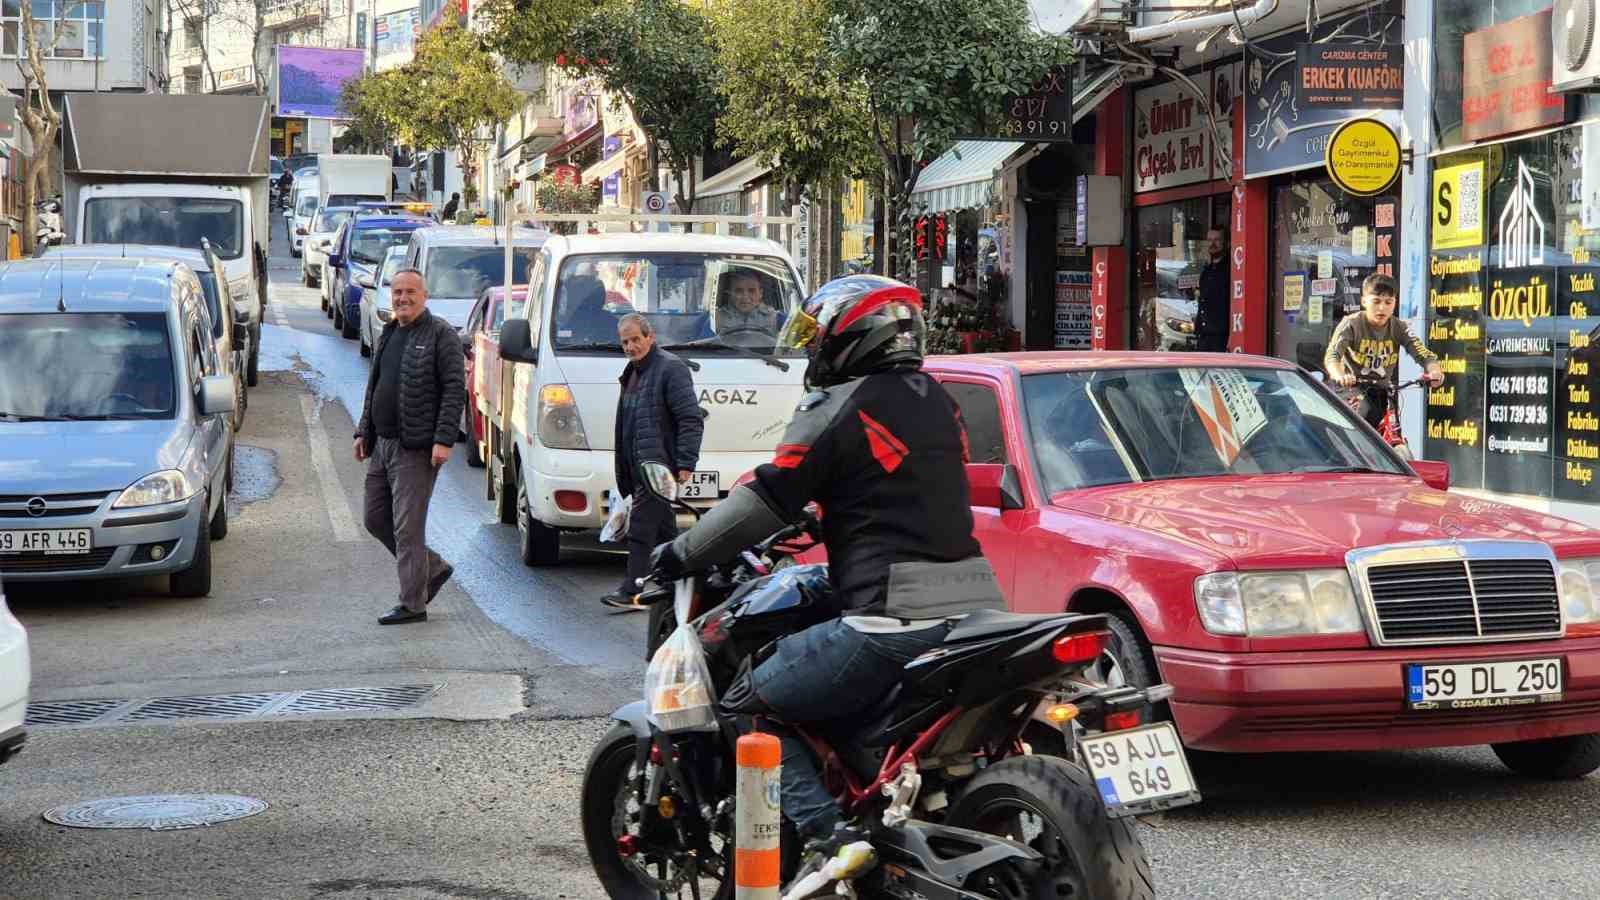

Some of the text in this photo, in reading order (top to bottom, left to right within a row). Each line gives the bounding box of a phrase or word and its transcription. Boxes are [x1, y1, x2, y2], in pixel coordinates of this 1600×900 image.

[1302, 67, 1345, 89] ERKEK
[1027, 120, 1043, 134] 91
[1049, 121, 1066, 135] 91
[1338, 148, 1390, 159] Gayrimenkul
[1137, 141, 1177, 186] Çiçek
[1431, 251, 1481, 280] Gayrimenkul
[1489, 276, 1552, 328] ÖZGÜL
[1430, 321, 1448, 340] Alım
[1455, 319, 1480, 340] Satım
[1569, 329, 1590, 348] Büro
[1568, 357, 1589, 375] Arsa
[1490, 377, 1510, 394] 0546
[1510, 376, 1524, 394] 741
[1537, 376, 1548, 394] 82
[698, 389, 758, 405] AGAZ
[1489, 405, 1508, 423] 0531
[1428, 418, 1442, 438] Kat
[685, 485, 701, 497] 23
[22, 532, 50, 549] AFR
[58, 531, 86, 548] 446
[1425, 668, 1456, 697] 59
[1472, 666, 1507, 695] DL
[1517, 662, 1559, 692] 250
[1087, 733, 1175, 768] 59 AJL
[1128, 766, 1172, 795] 649
